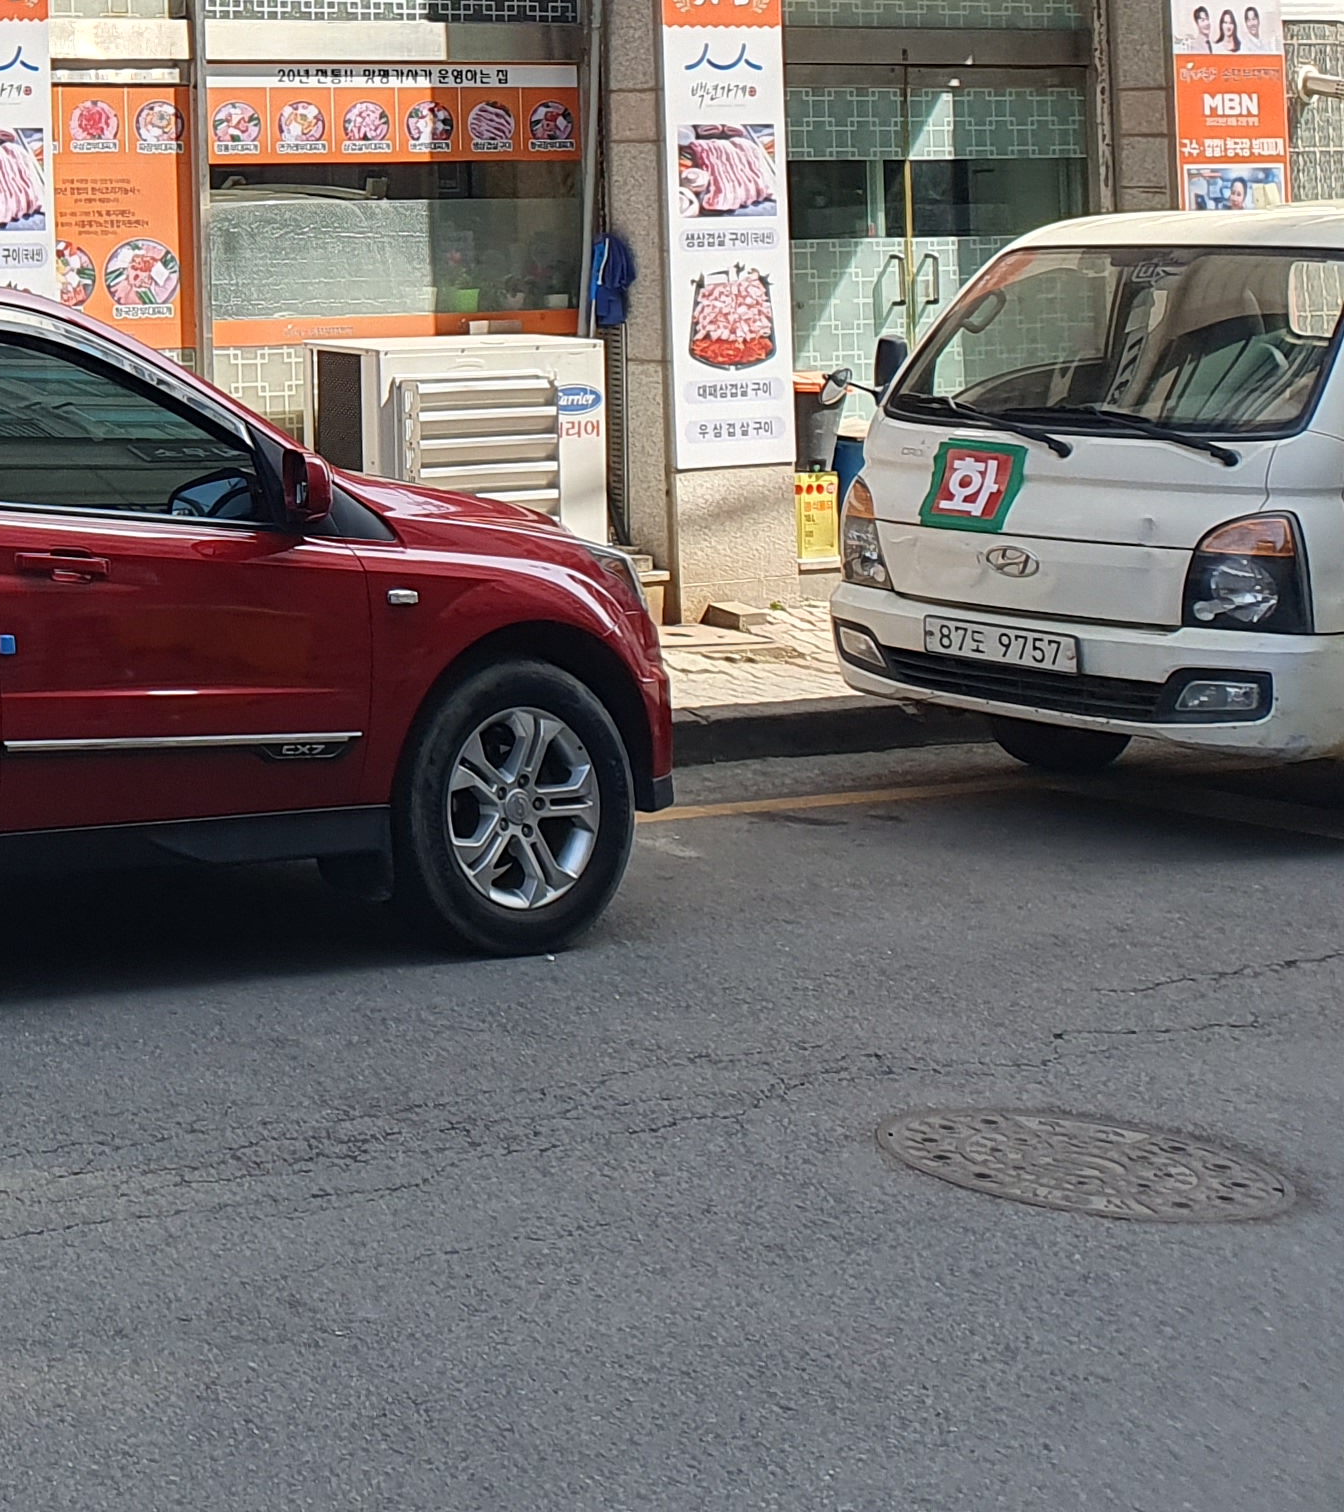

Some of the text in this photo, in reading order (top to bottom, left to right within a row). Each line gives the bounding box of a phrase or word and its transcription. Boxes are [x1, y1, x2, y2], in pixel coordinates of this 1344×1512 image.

[278, 68, 310, 84] 20년
[496, 69, 508, 84] 집
[690, 82, 748, 109] 백년가게
[1203, 94, 1259, 116] MBN
[685, 232, 727, 248] 생삼겹살
[698, 381, 772, 399] 대패삼겹살 구이
[753, 419, 773, 436] 구이
[939, 456, 999, 517] 화
[938, 624, 1062, 667] 87도 9757
[282, 745, 325, 754] CX7
